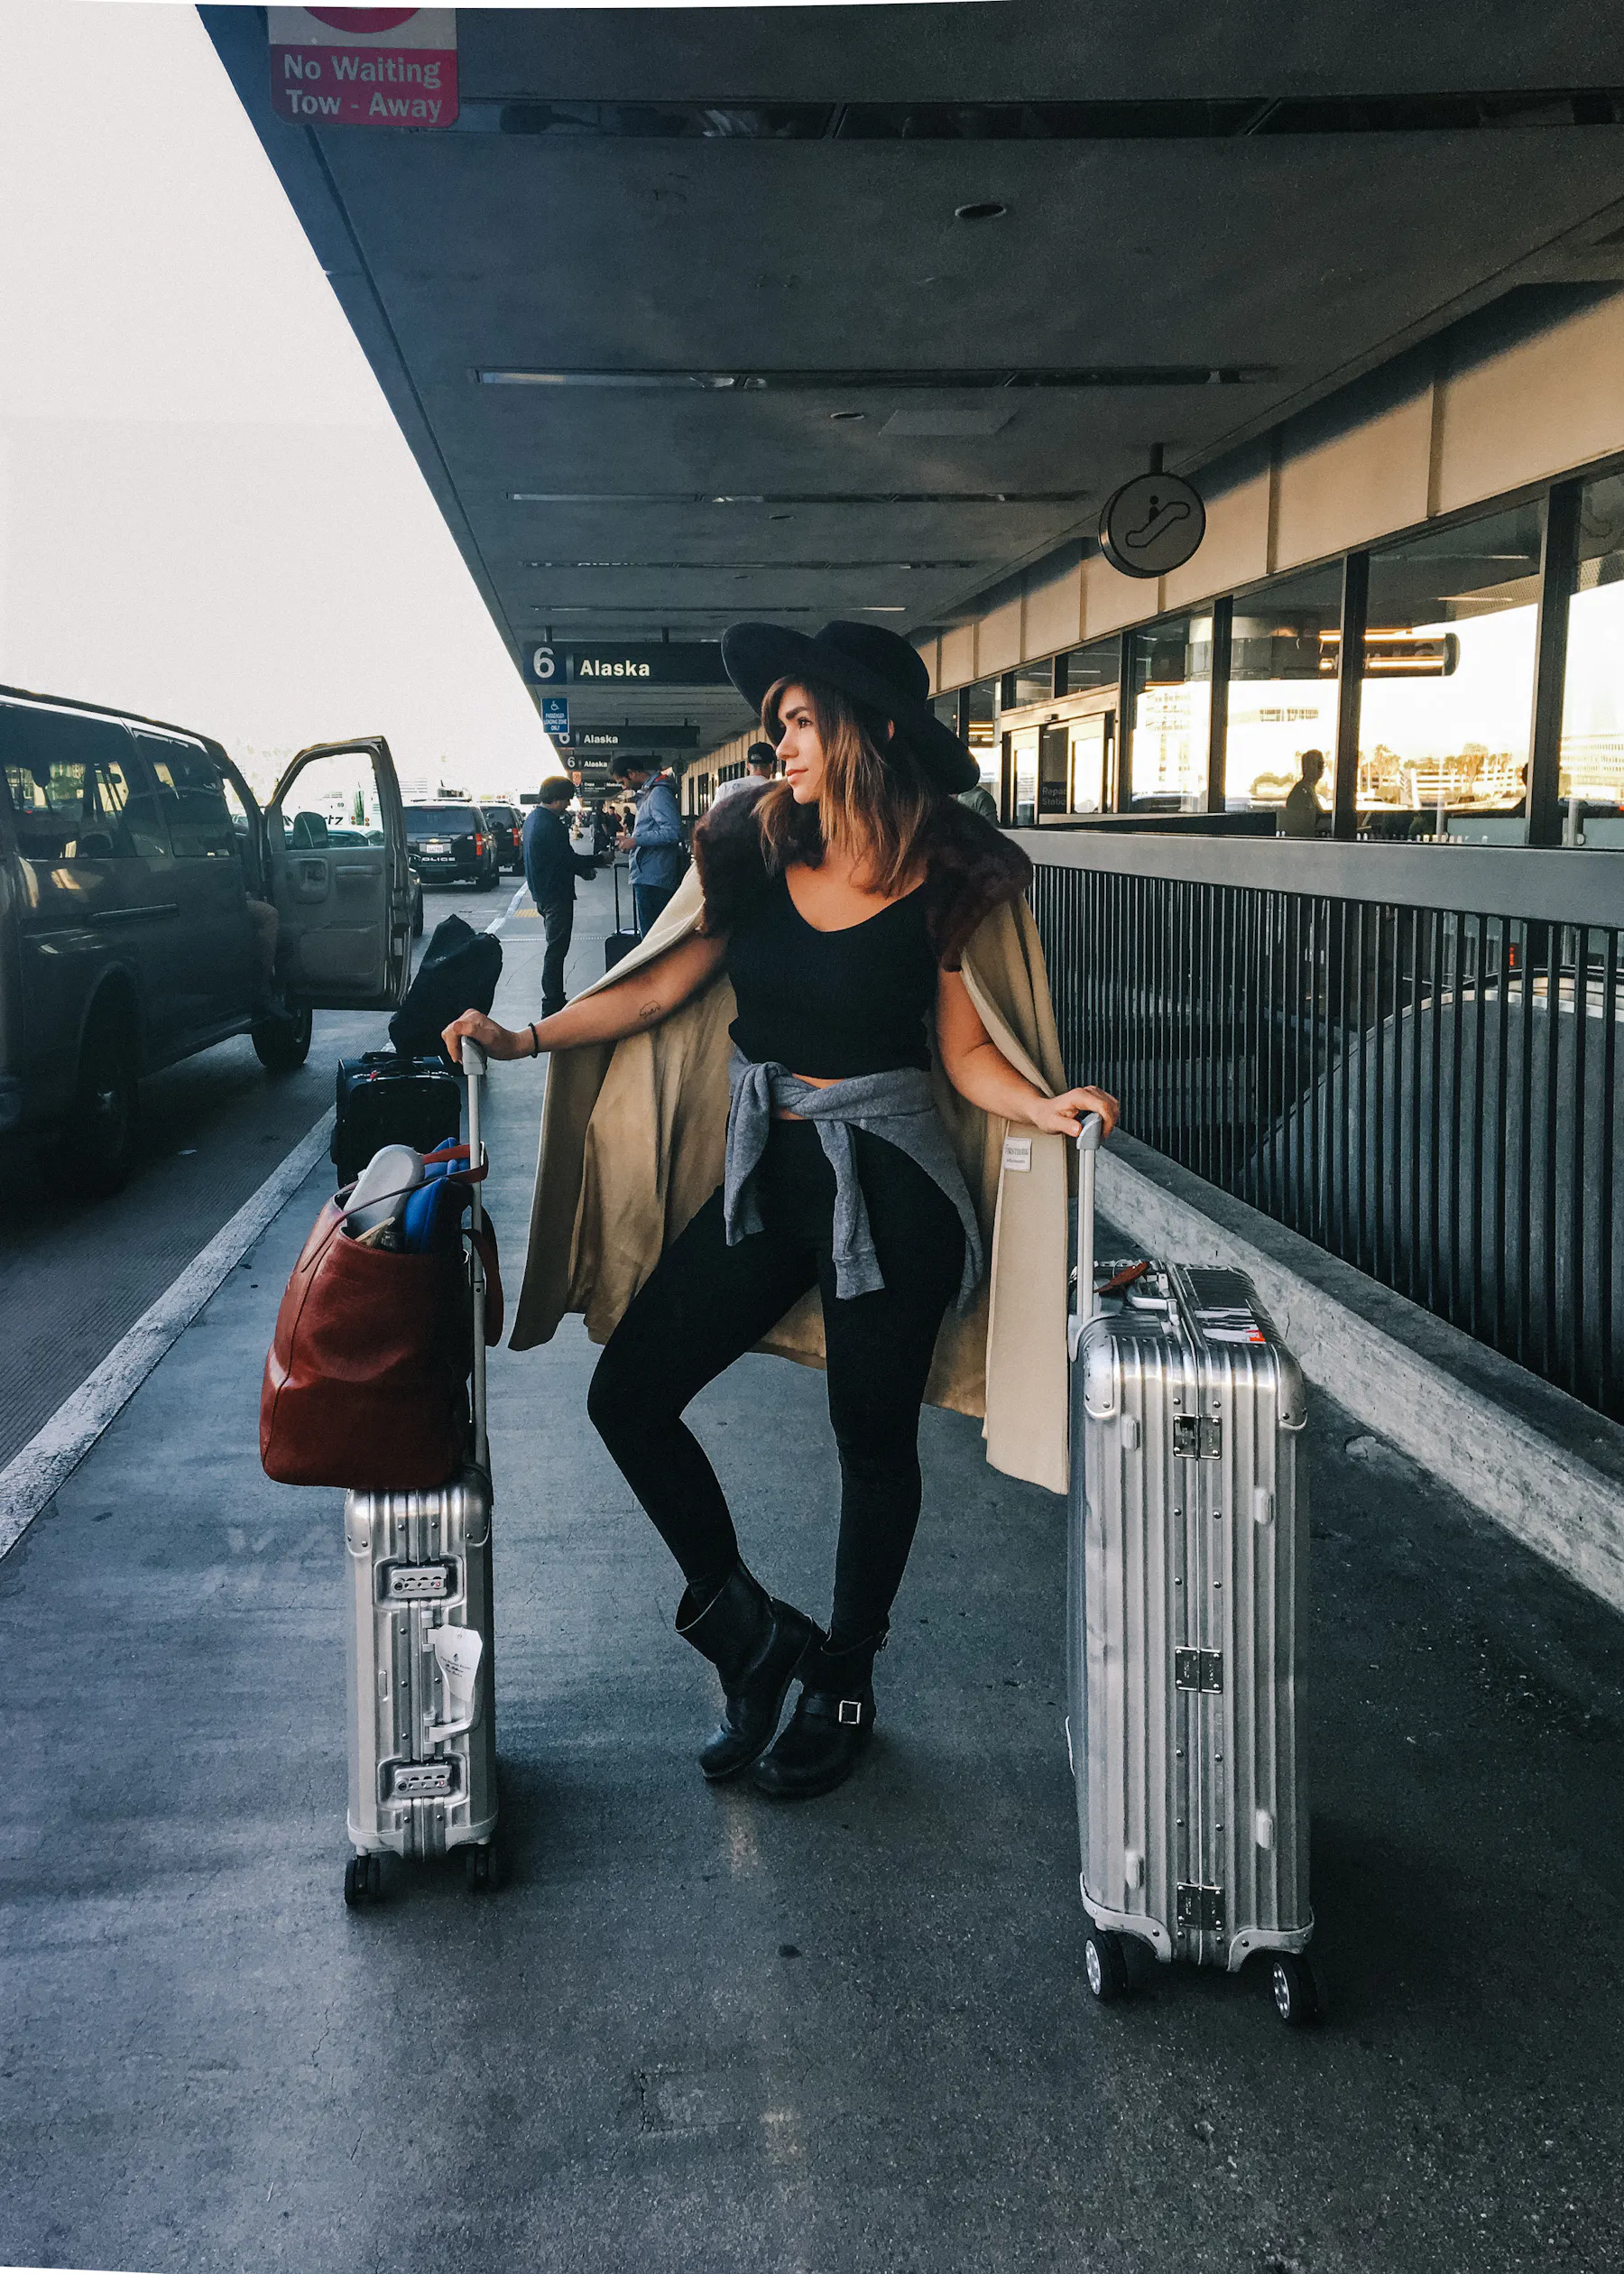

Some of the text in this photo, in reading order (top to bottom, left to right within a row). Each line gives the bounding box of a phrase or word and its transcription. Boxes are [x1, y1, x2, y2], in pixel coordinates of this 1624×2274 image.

[283, 54, 441, 88] No Waiting
[285, 89, 342, 115] Tow
[368, 92, 442, 124] Away
[533, 647, 651, 678] 6 Alaska
[584, 735, 618, 744] Alaska
[567, 756, 576, 768] 6
